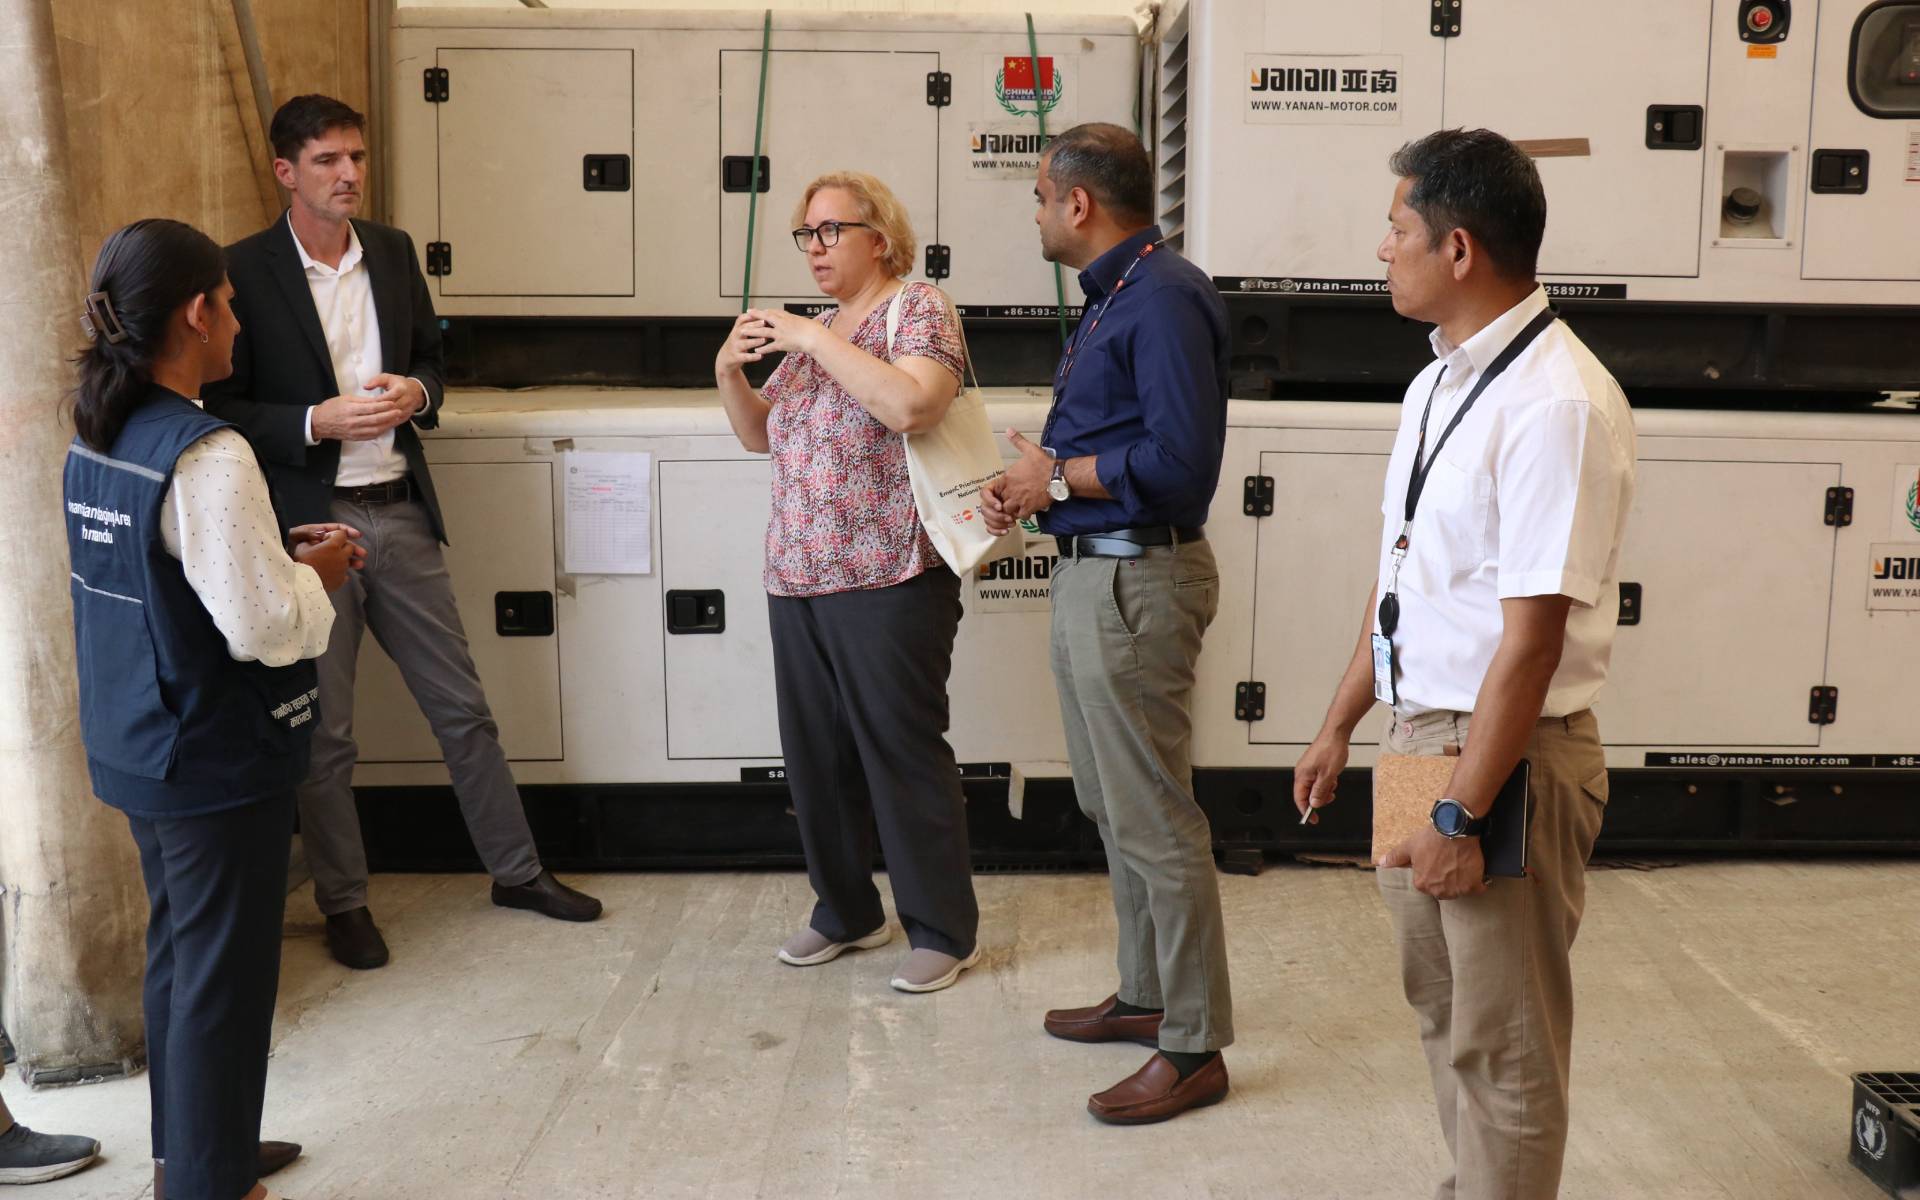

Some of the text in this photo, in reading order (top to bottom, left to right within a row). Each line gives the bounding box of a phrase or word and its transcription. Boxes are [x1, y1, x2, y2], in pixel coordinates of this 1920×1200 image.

[1341, 69, 1397, 93] 亚南
[1005, 88, 1036, 96] CHINA
[1250, 101, 1398, 112] WWW.YANAN-MOTOR.COM
[1004, 307, 1083, 317] +86-593-589
[1669, 754, 1850, 767] sales@yanan-motor.com
